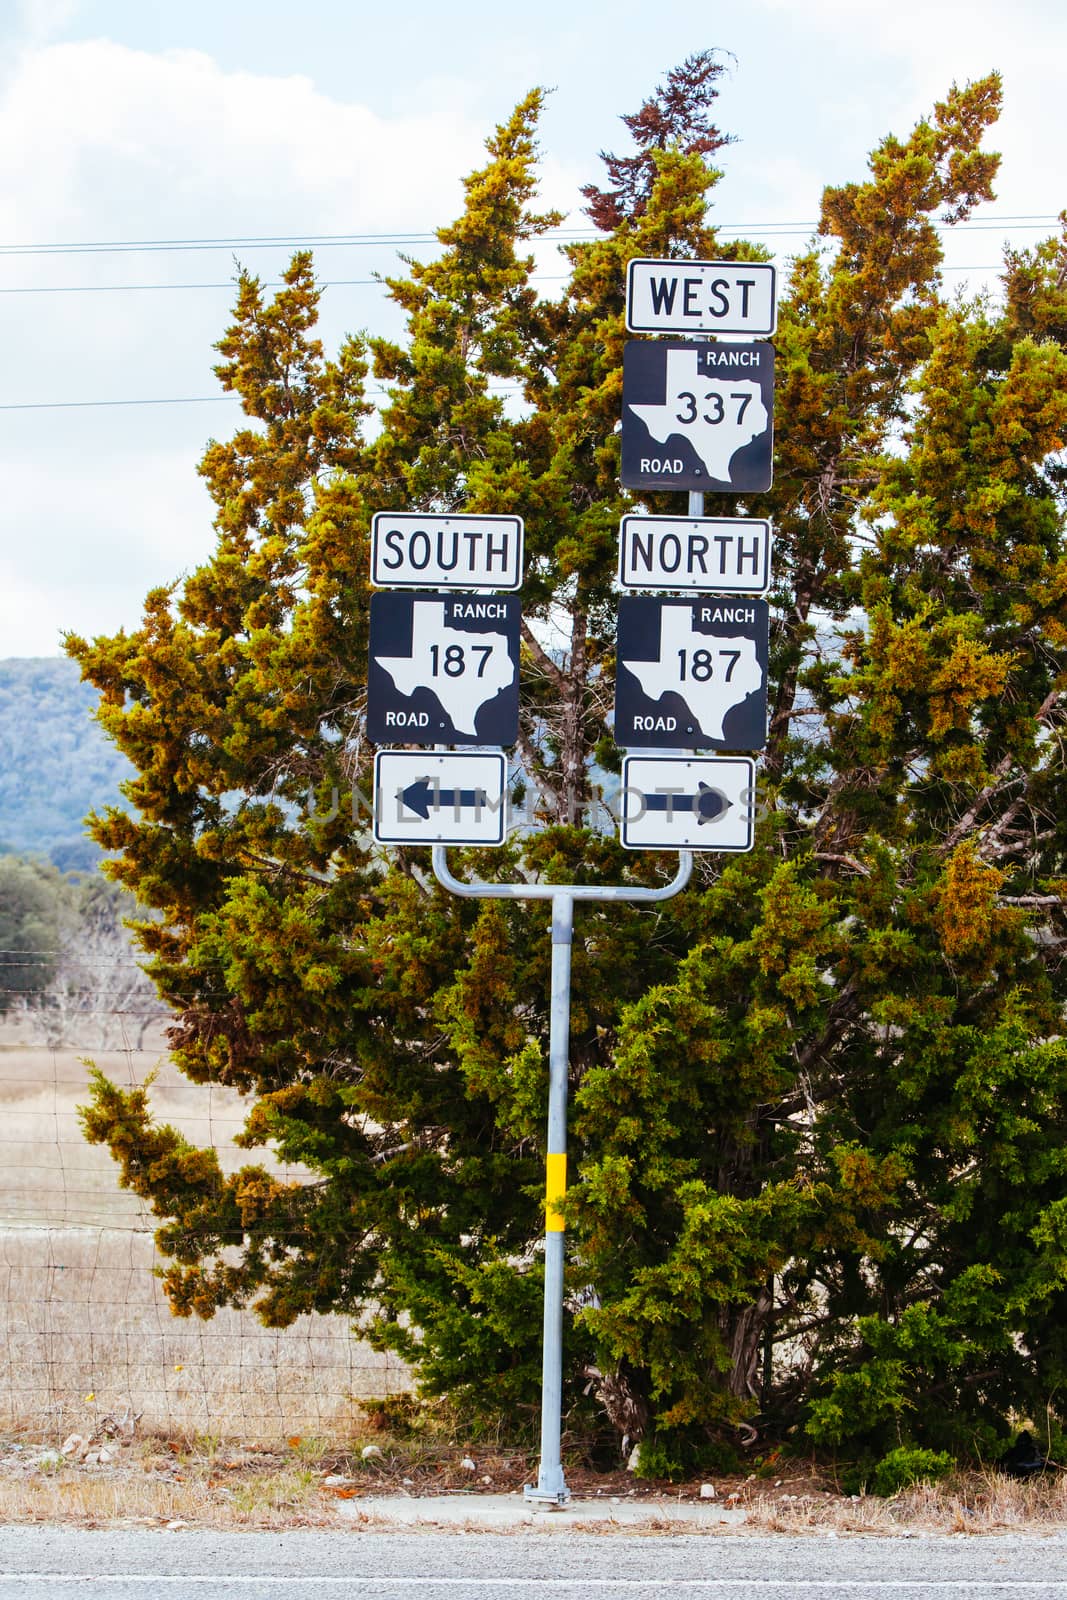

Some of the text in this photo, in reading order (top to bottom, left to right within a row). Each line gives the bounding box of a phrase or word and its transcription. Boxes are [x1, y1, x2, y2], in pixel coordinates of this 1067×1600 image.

[650, 277, 756, 318] WEST
[706, 351, 760, 366] RANCH
[676, 391, 753, 425] 337
[640, 458, 684, 473] ROAD
[382, 529, 509, 573] SOUTH
[631, 532, 760, 576] NORTH
[452, 603, 507, 619] RANCH
[701, 608, 755, 624] RANCH
[430, 644, 493, 678] 187
[677, 648, 741, 683] 187
[385, 711, 429, 727] ROAD
[633, 716, 677, 731] ROAD
